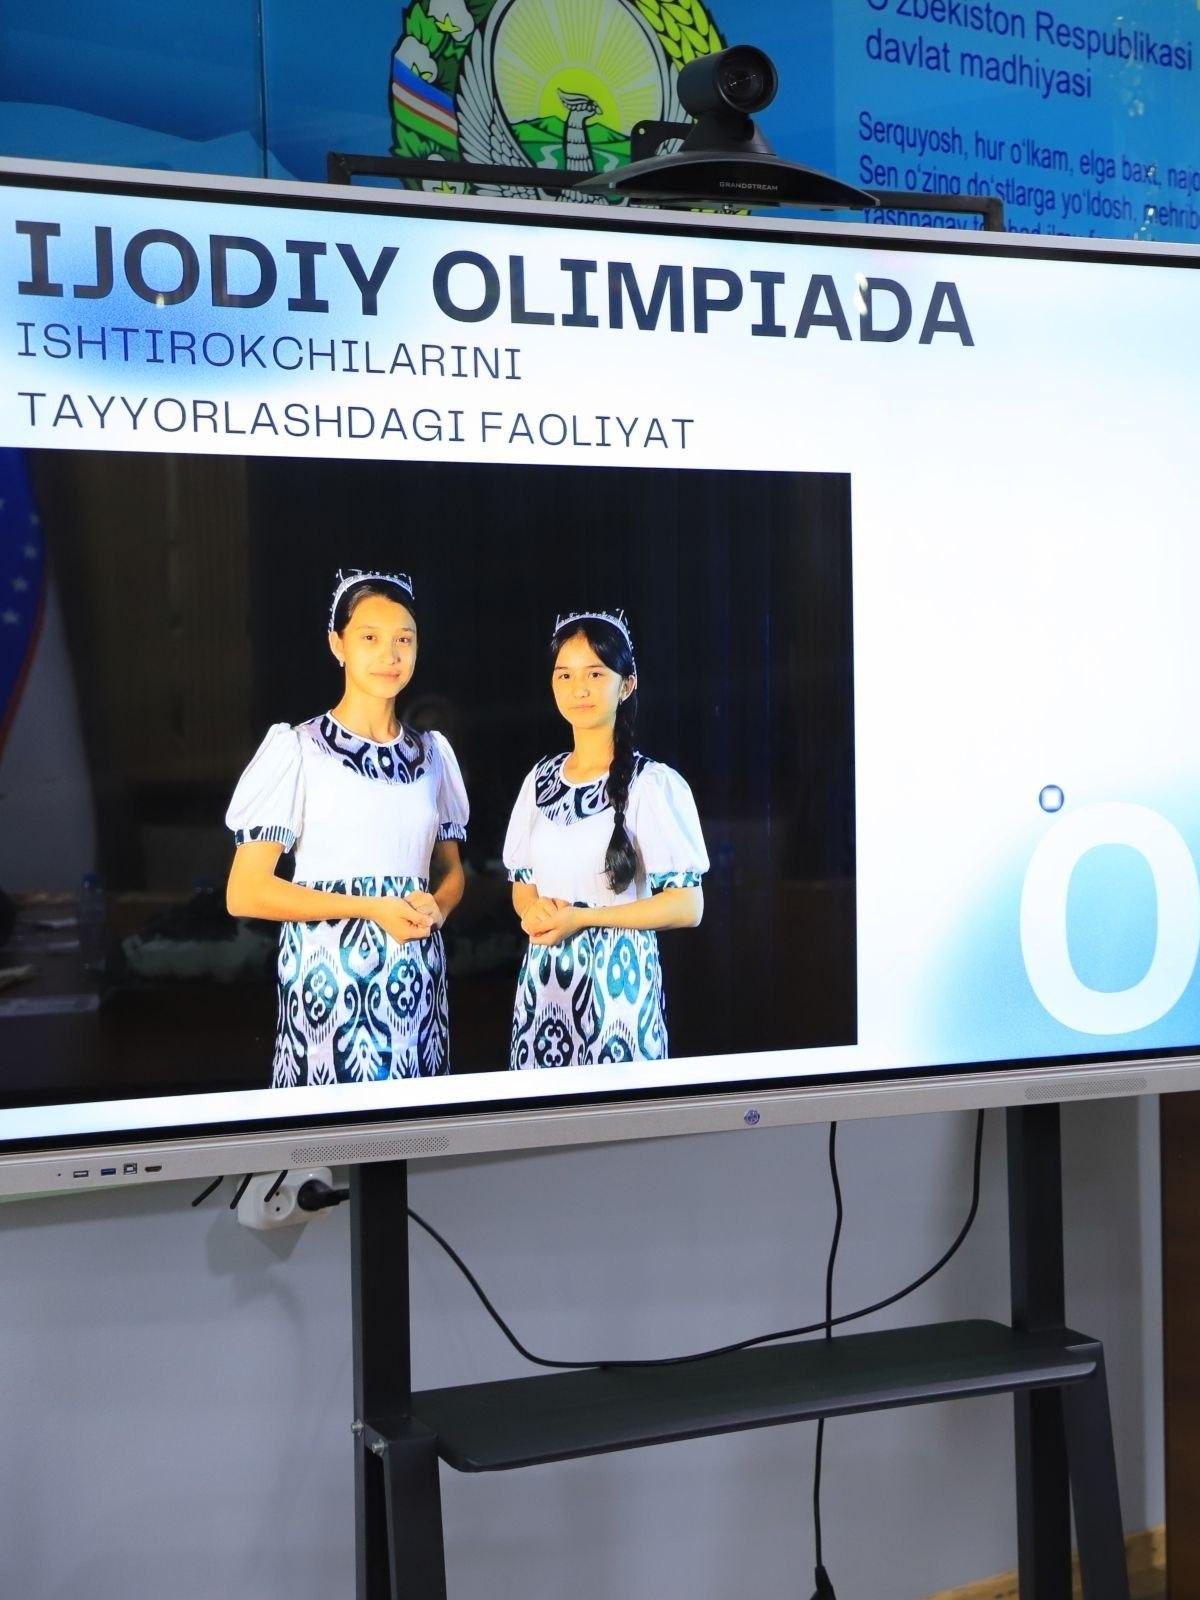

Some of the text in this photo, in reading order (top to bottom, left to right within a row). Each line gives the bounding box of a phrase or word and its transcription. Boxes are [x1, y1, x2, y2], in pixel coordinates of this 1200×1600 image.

[866, 27, 1092, 99] davlat madhiyasi
[867, 0, 1193, 71] zbekiston Respublikasi
[859, 111, 968, 160] Serquyosh,
[975, 130, 1006, 161] hur
[1080, 149, 1116, 184] elga
[859, 155, 898, 187] Sen
[719, 181, 778, 191] GRANDSTREAM
[15, 220, 975, 347] IJODIY OLIMPIADA
[16, 321, 522, 380] ISHTIROKCHILARINI
[17, 391, 695, 449] TAYYORLASHDAGI FAOLIYAT
